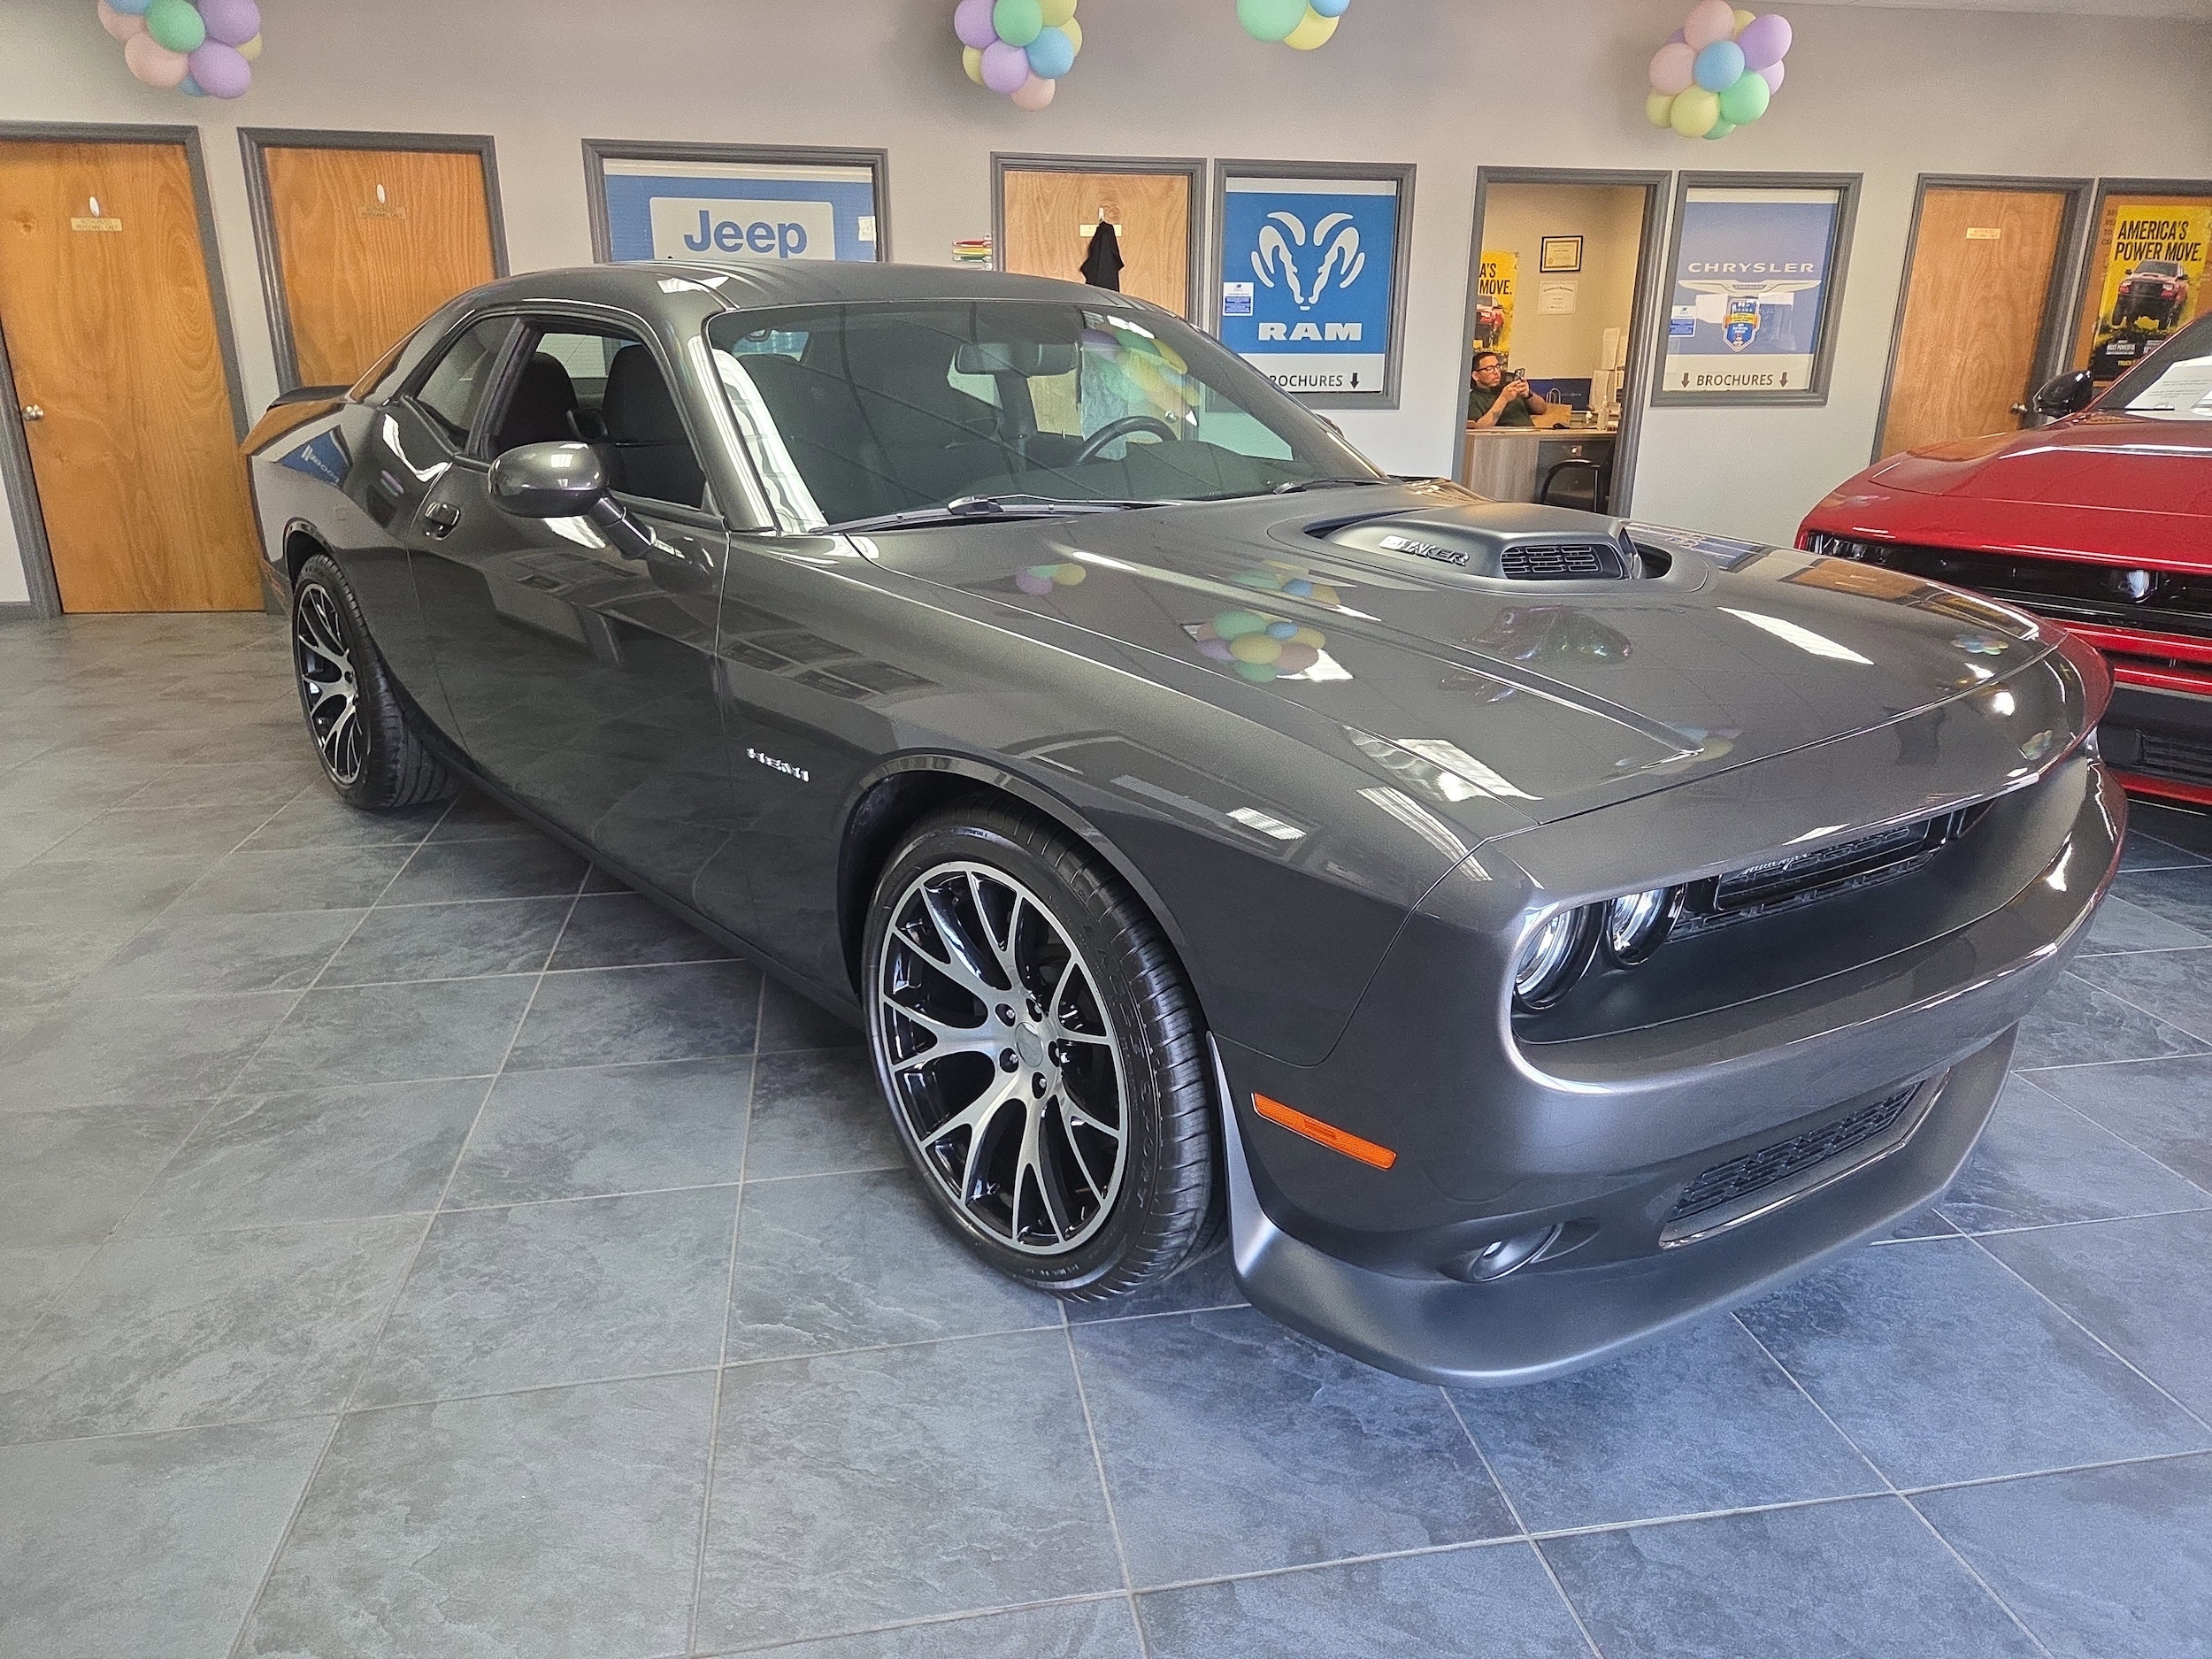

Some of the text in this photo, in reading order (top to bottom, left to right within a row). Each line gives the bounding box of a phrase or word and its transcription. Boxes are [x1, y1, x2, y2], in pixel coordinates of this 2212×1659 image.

[684, 210, 808, 258] Jeep
[2117, 220, 2189, 241] AMERICA'S
[2115, 242, 2202, 262] POWER MOVE.
[1688, 263, 1814, 273] CHRYSLER
[1479, 280, 1512, 295] MOVE.
[1258, 322, 1363, 341] RAM
[1270, 375, 1343, 387] ROCHURES
[1696, 374, 1774, 387] BROCHURES
[746, 748, 810, 782] HEMI
